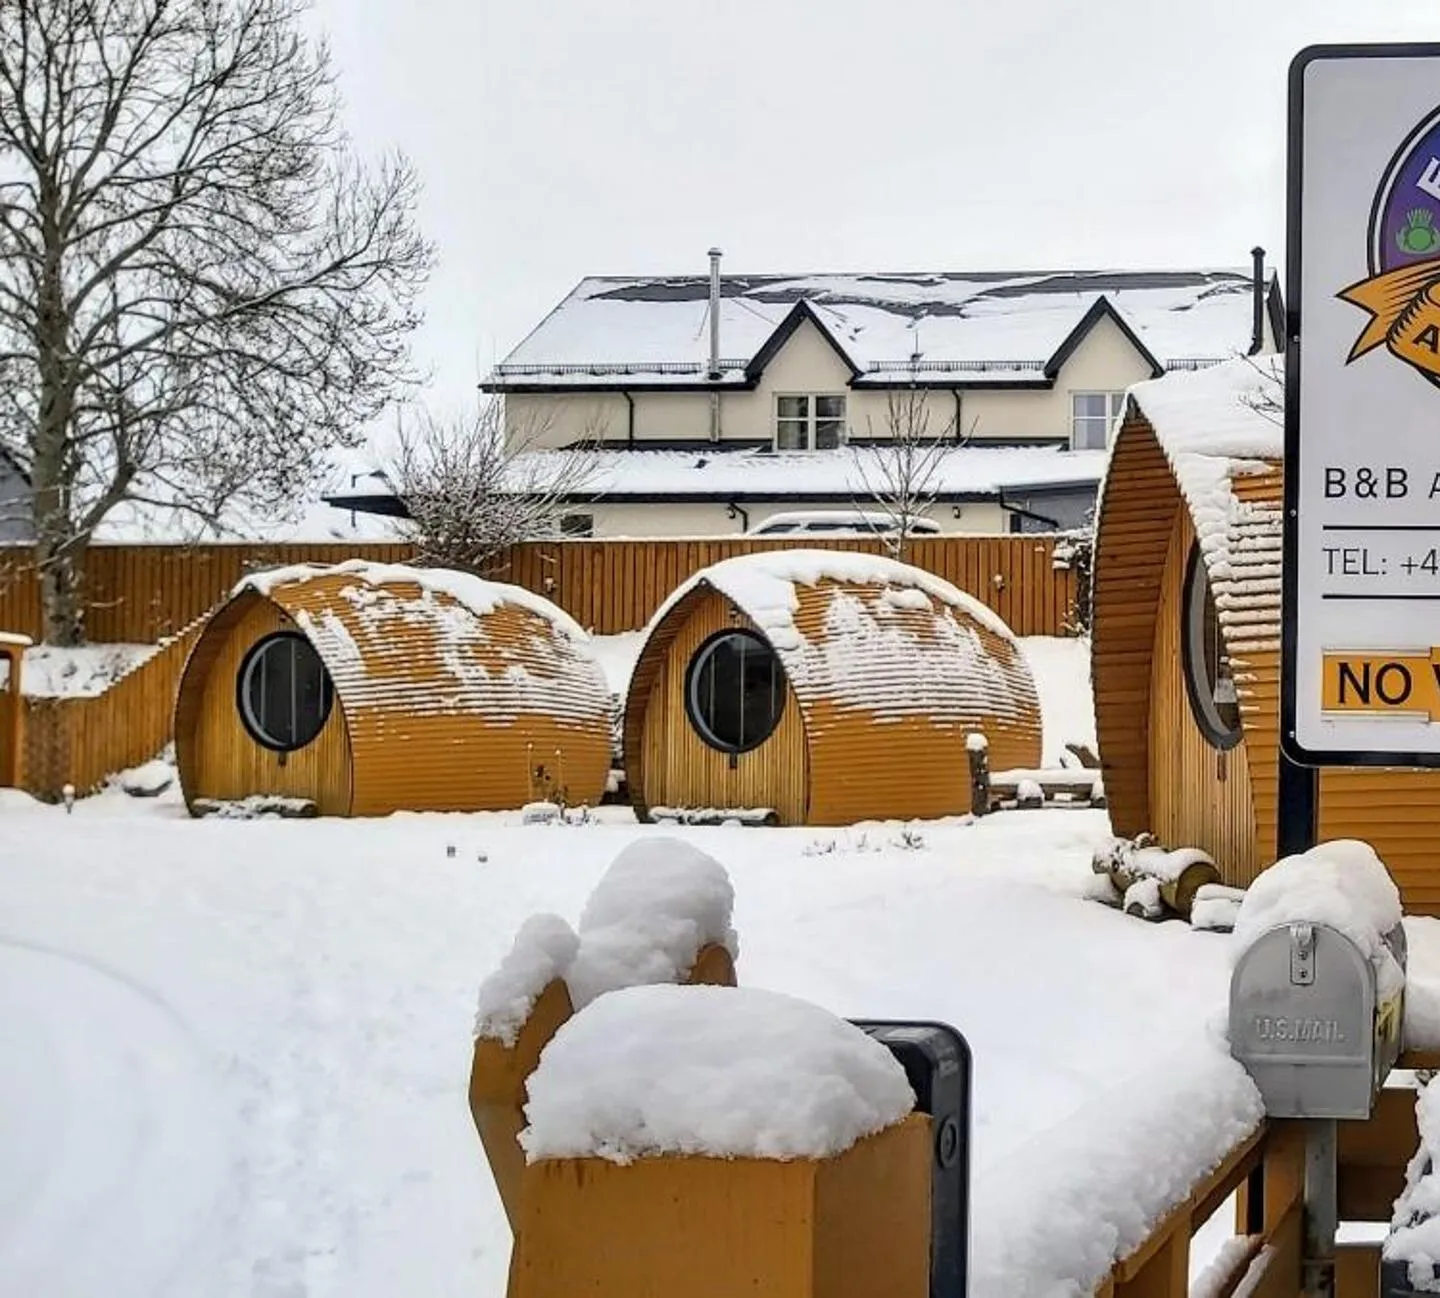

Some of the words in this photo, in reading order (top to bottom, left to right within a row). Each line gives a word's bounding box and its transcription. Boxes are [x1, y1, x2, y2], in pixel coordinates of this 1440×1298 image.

[1323, 467, 1409, 499] B&B
[1322, 548, 1388, 576] TEL:
[1337, 661, 1413, 706] NO
